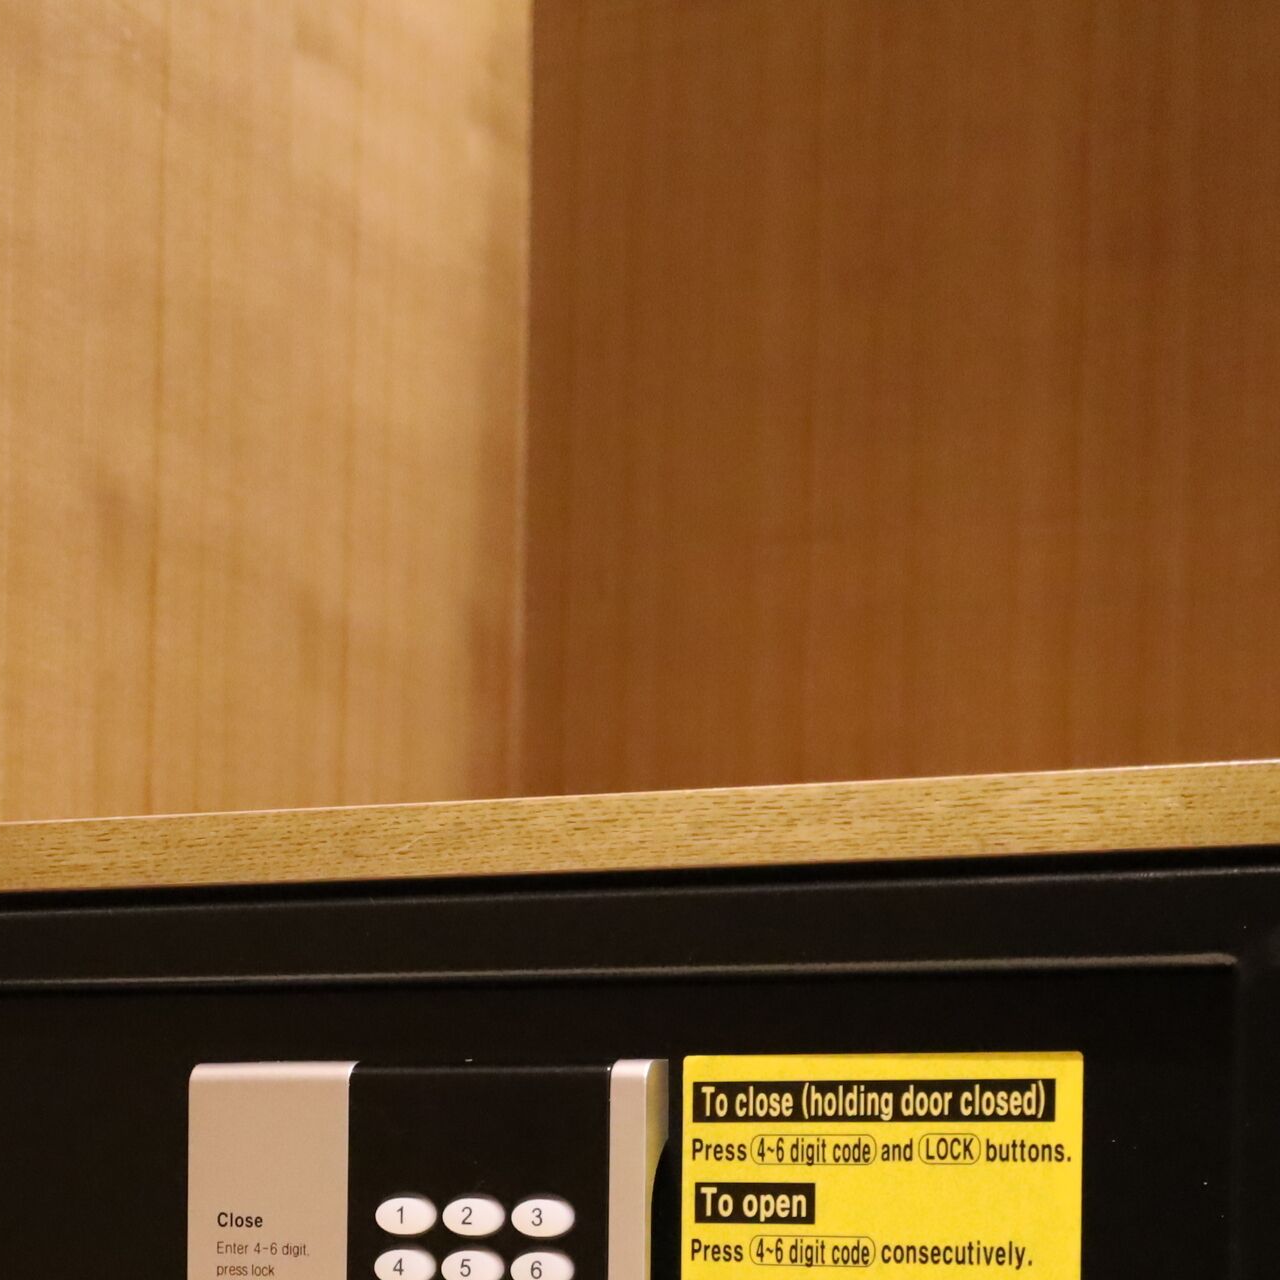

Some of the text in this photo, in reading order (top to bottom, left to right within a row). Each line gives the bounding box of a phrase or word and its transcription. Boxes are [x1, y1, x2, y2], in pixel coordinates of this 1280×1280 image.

[701, 1080, 1045, 1121] To close (holding door closed)
[692, 1138, 1071, 1165] Press 4~6 digit code and LOCK buttons.
[700, 1187, 807, 1222] To open
[217, 1212, 263, 1228] Close
[396, 1206, 404, 1224] 1
[461, 1207, 472, 1225] 2
[531, 1208, 543, 1227] 3
[216, 1241, 248, 1255] Enter
[254, 1242, 278, 1255] 4-6
[691, 1239, 1033, 1270] Press 4~6 digit code consecutively.
[216, 1264, 275, 1277] press lock
[393, 1258, 404, 1276] 4
[460, 1259, 471, 1277] 5
[530, 1261, 542, 1279] 6
